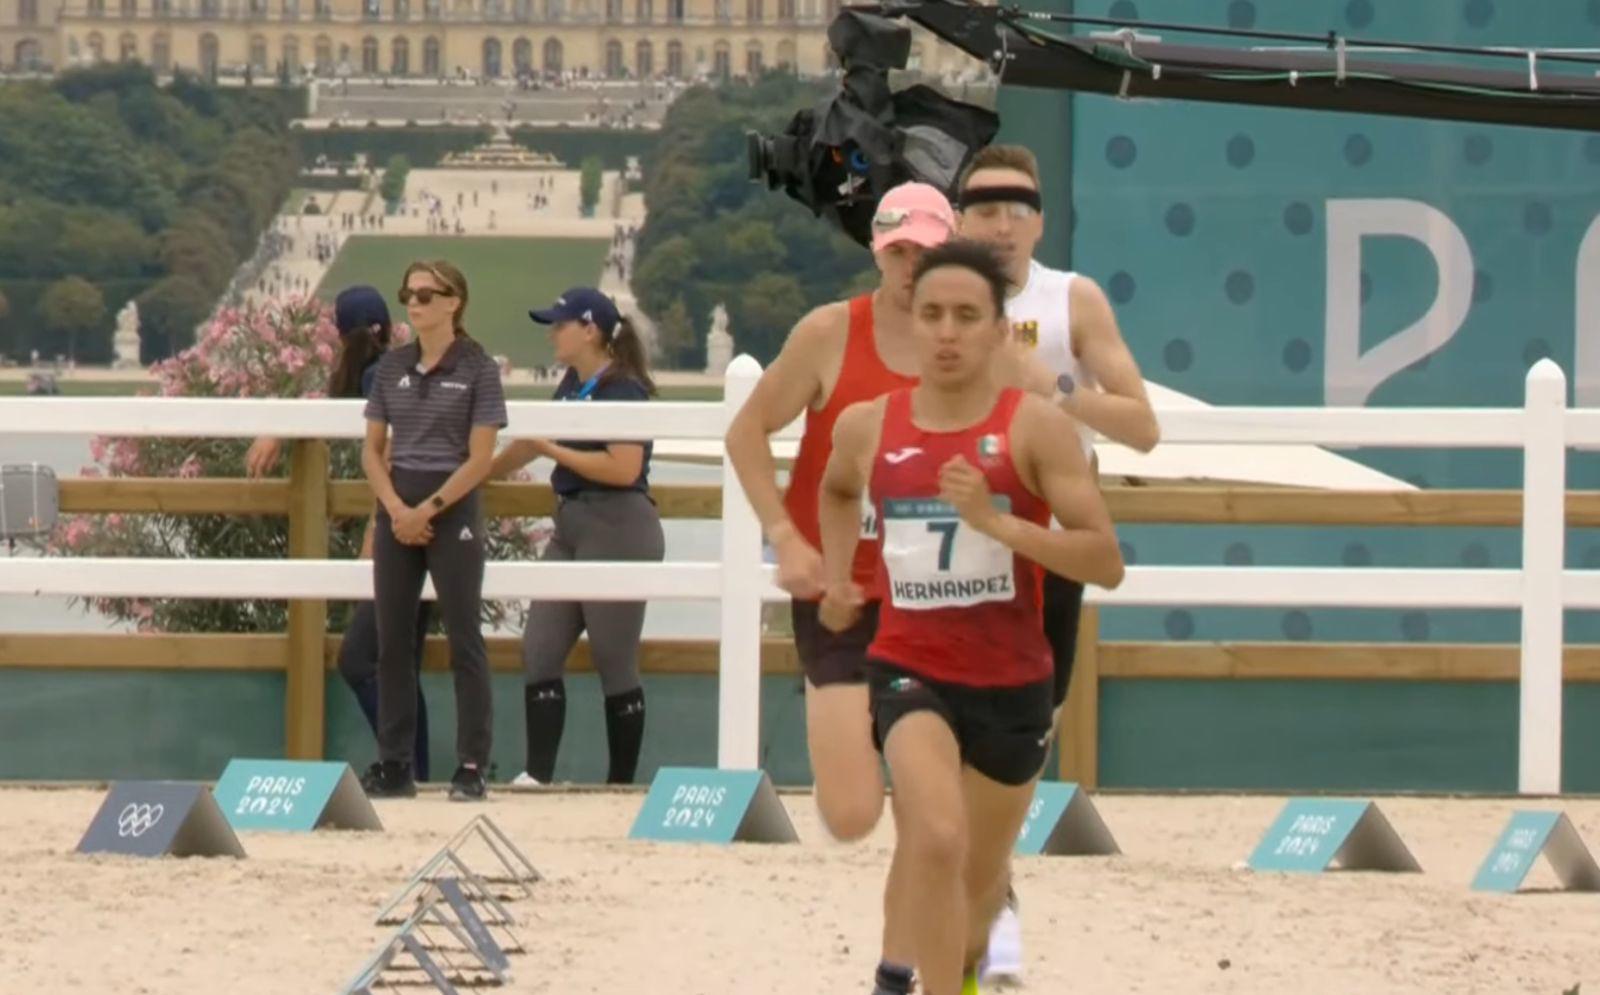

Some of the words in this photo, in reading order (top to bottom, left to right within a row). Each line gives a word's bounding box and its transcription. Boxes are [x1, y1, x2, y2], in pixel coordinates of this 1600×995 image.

[927, 521, 958, 571] 7
[894, 574, 1010, 600] HERNANDEZ
[246, 776, 306, 795] PARIS
[672, 785, 726, 806] PARIS
[235, 796, 293, 815] 2024
[662, 807, 715, 827] 2024
